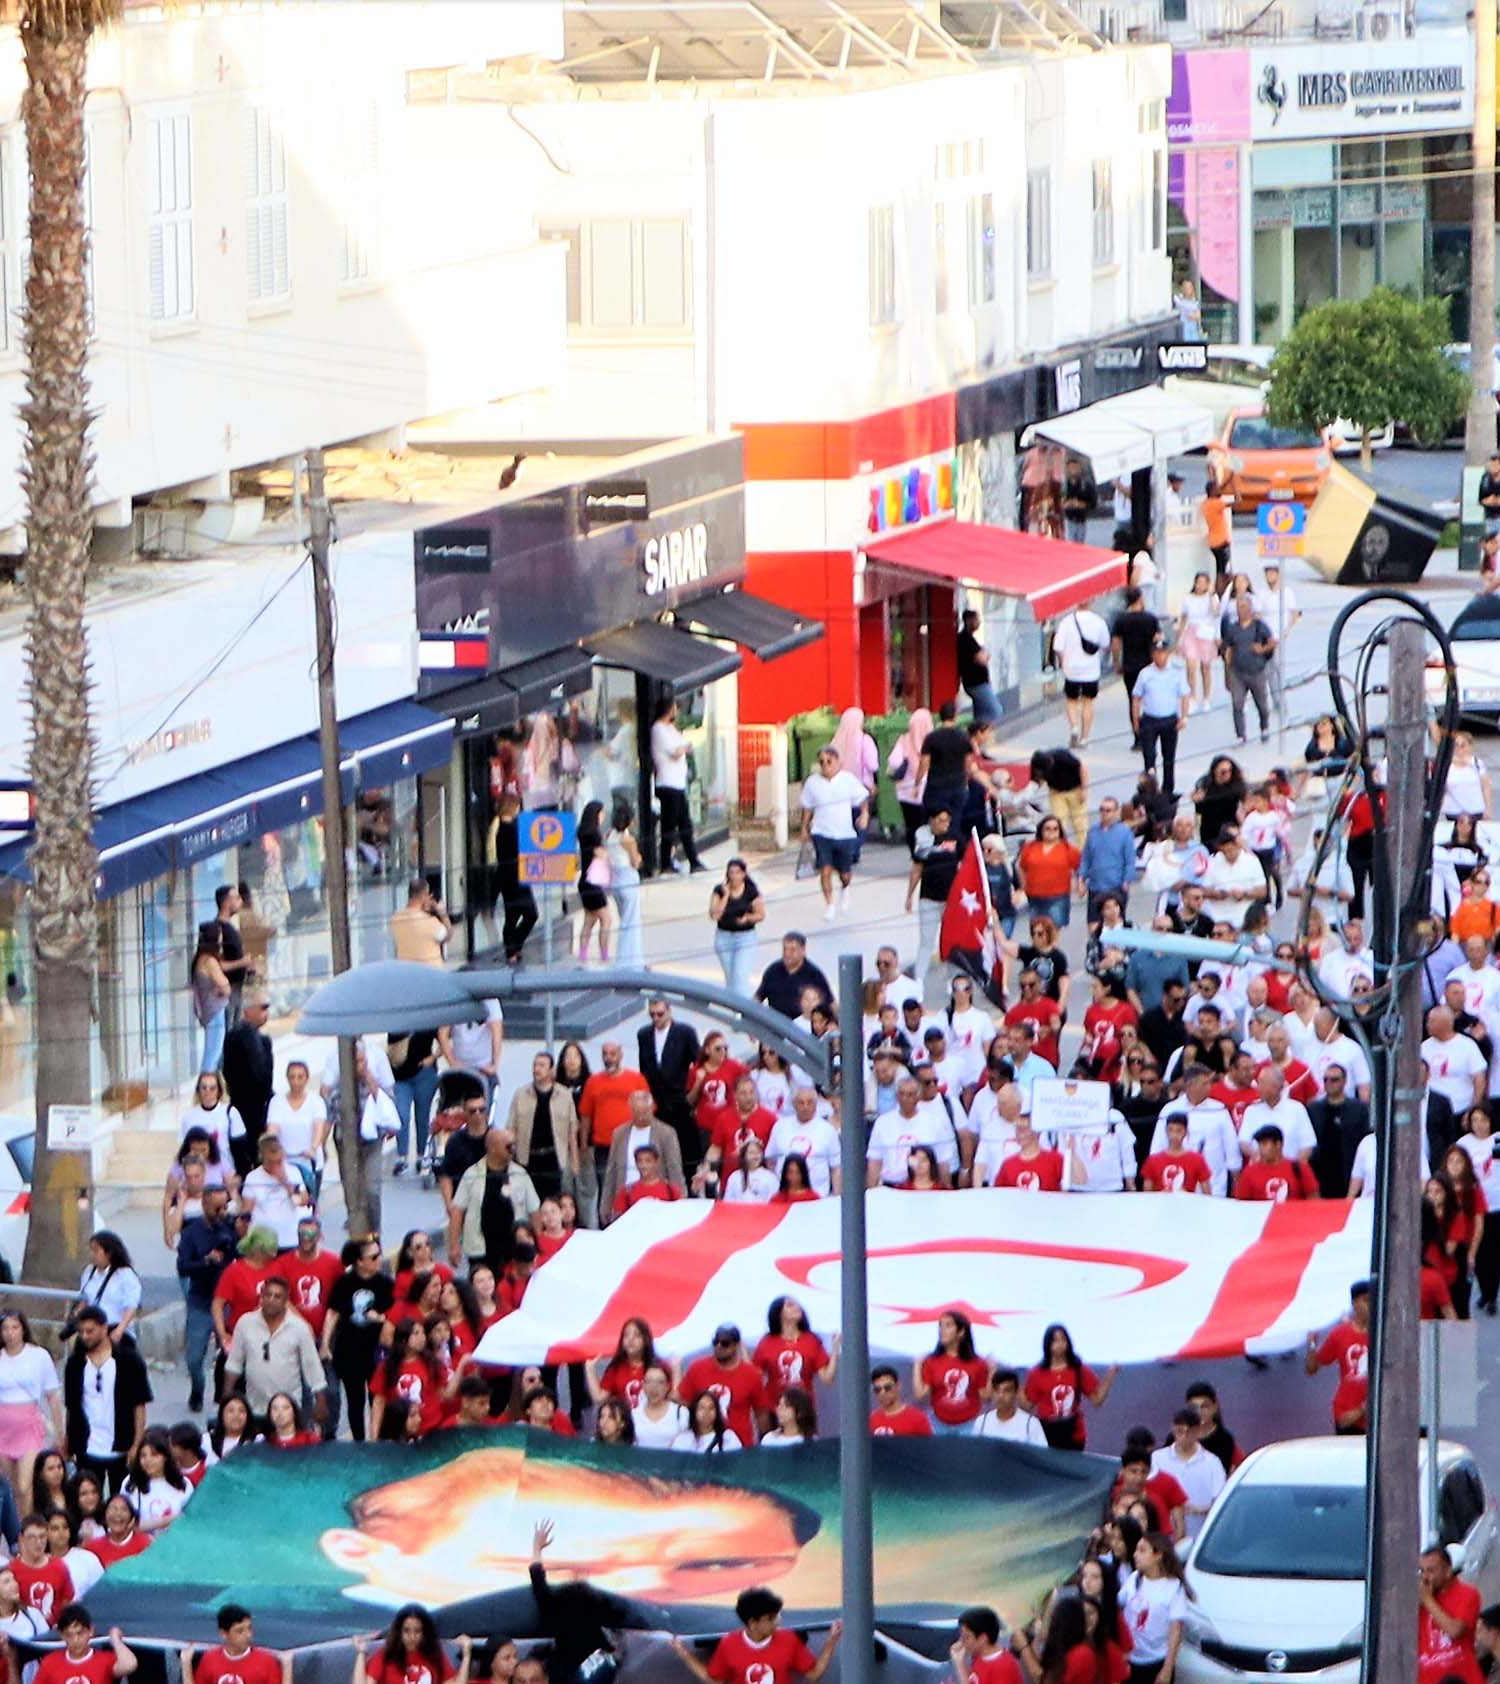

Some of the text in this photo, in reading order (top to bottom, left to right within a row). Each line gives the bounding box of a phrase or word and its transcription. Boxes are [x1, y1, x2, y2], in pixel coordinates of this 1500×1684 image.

[1296, 71, 1347, 108] MRS
[1158, 345, 1207, 369] VANS
[643, 522, 709, 596] SARAR
[538, 822, 557, 843] P
